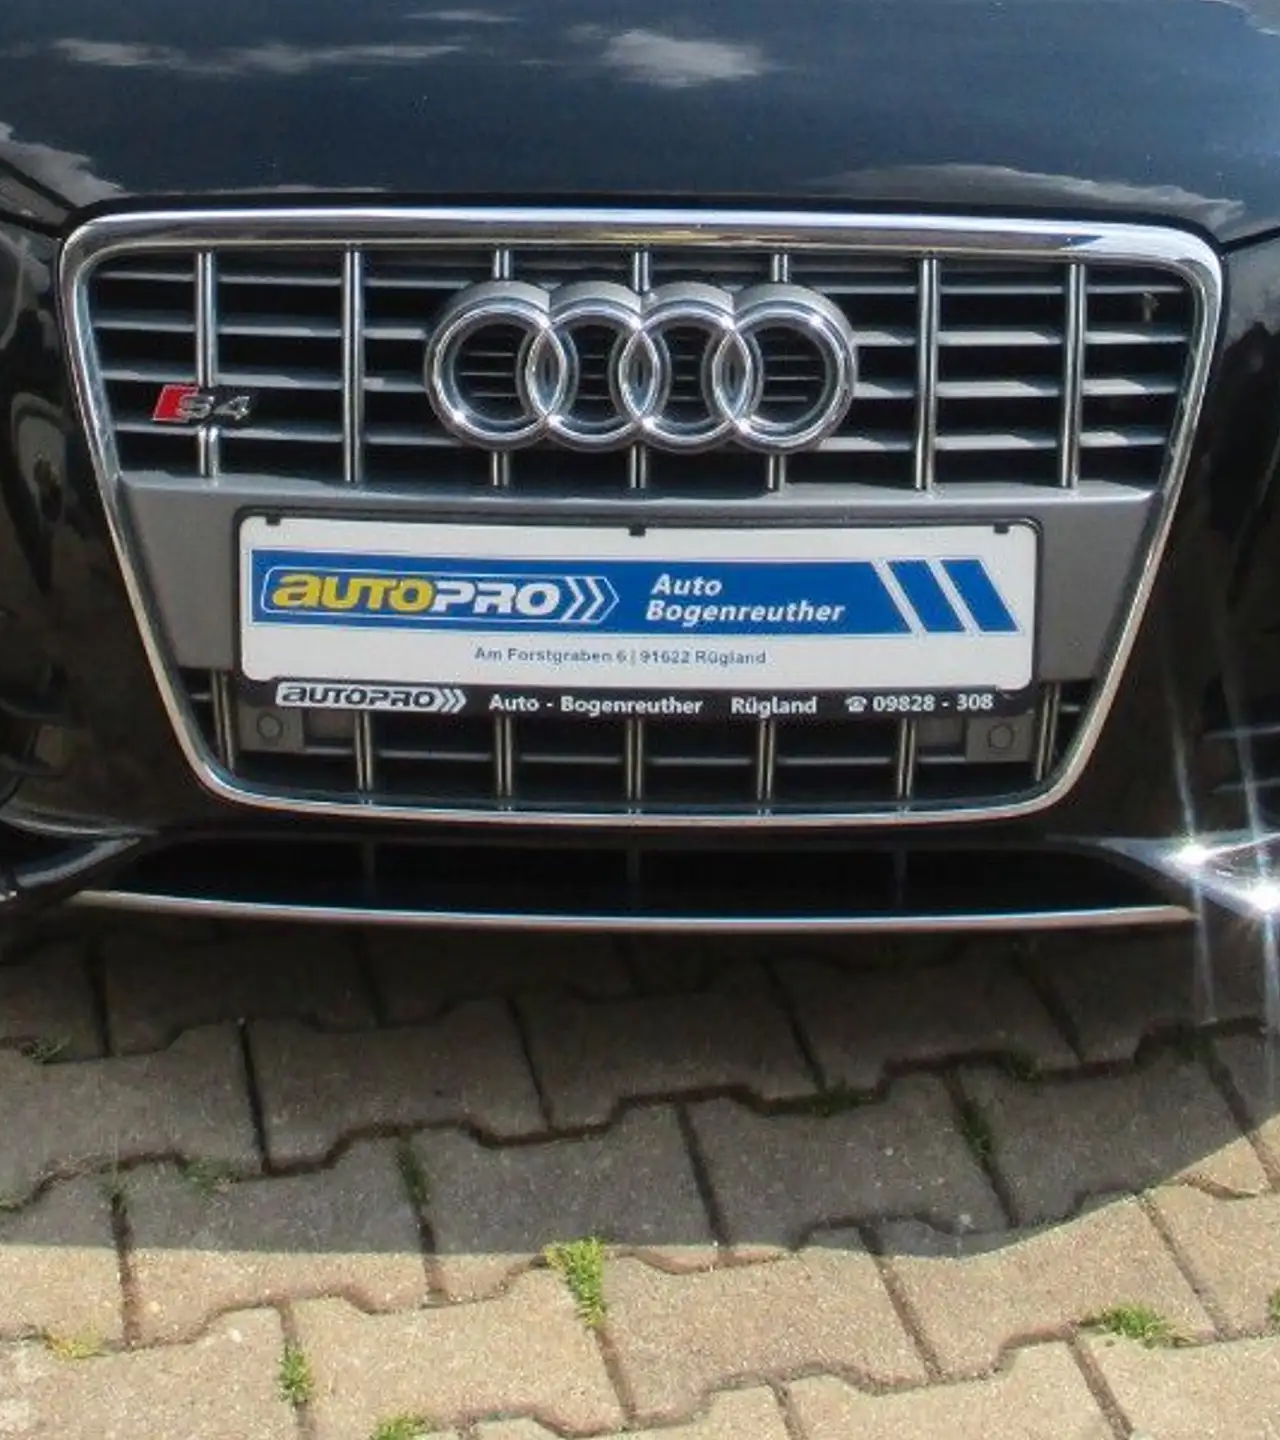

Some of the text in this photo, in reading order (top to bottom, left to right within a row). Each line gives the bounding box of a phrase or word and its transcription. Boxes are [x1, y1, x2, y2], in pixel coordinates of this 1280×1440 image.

[652, 574, 722, 596] Auto
[646, 601, 845, 627] Bogenreuther
[474, 647, 502, 660] Am
[507, 648, 612, 664] Forstgraben
[639, 650, 690, 664] 91622
[695, 649, 767, 667] Rügland
[488, 694, 540, 711] Auto
[560, 696, 704, 717] Bogenreuther
[731, 695, 818, 718] Rügland
[872, 695, 936, 712] 09828
[956, 693, 994, 711] 308
